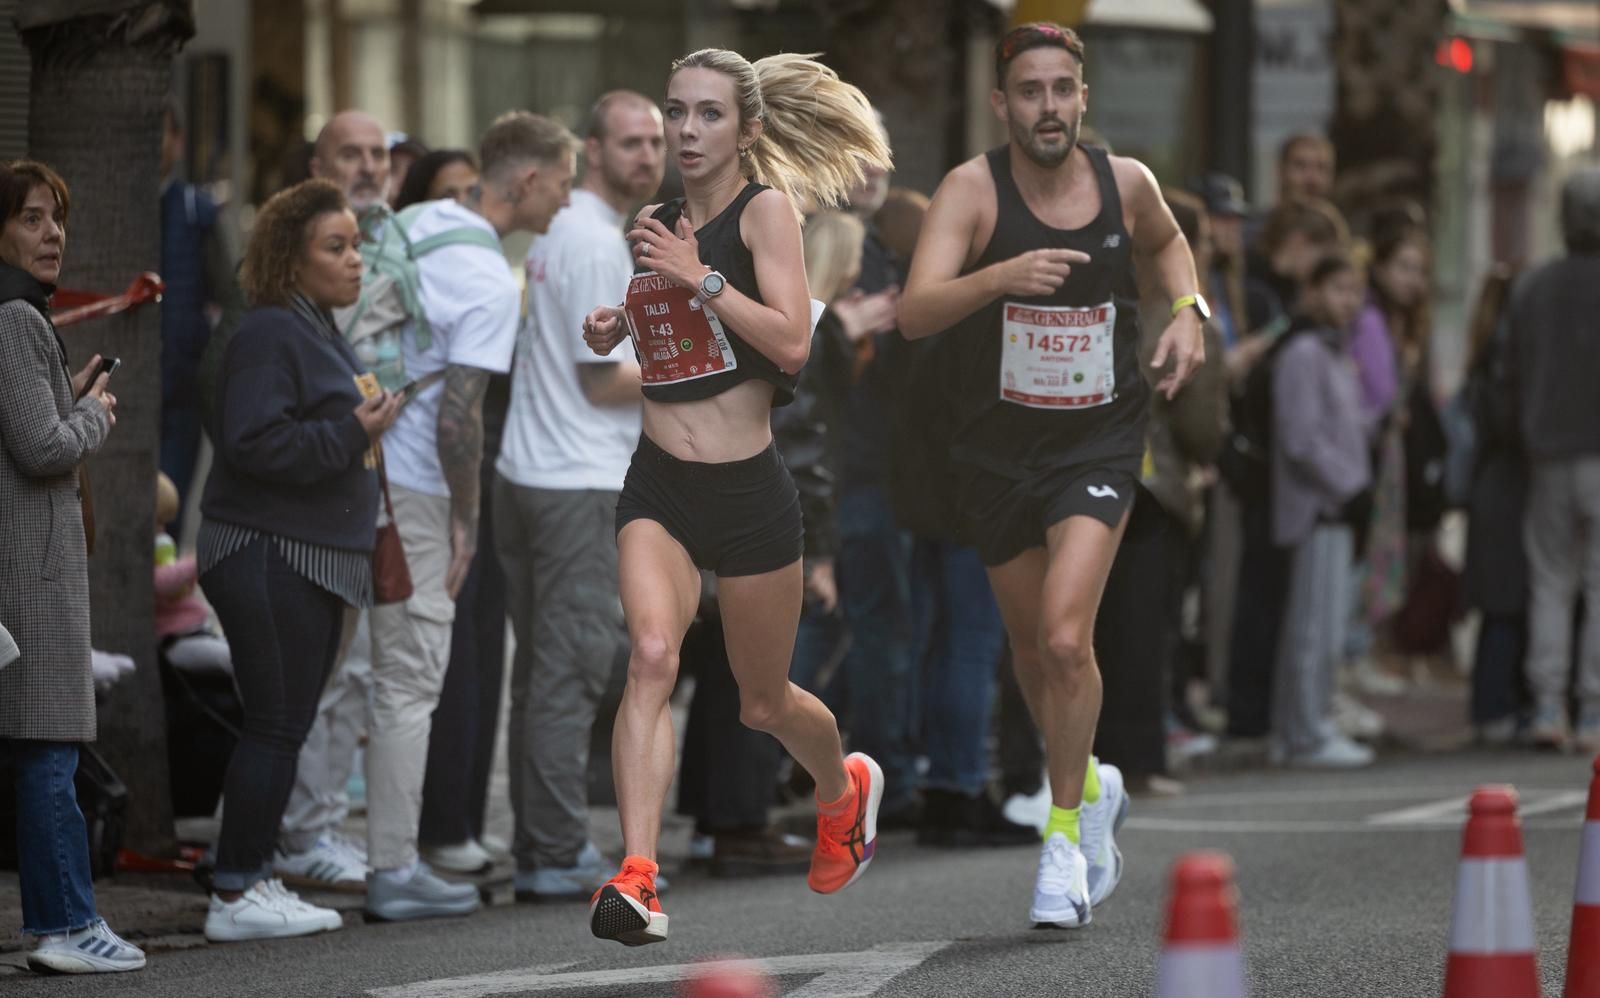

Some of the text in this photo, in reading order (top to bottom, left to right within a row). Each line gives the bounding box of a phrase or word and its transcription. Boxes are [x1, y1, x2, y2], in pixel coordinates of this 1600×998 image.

[644, 302, 670, 317] TALBI
[1034, 310, 1100, 328] GENERALI
[650, 323, 674, 337] F-43
[718, 337, 728, 351] BOX
[1026, 333, 1091, 353] 14572
